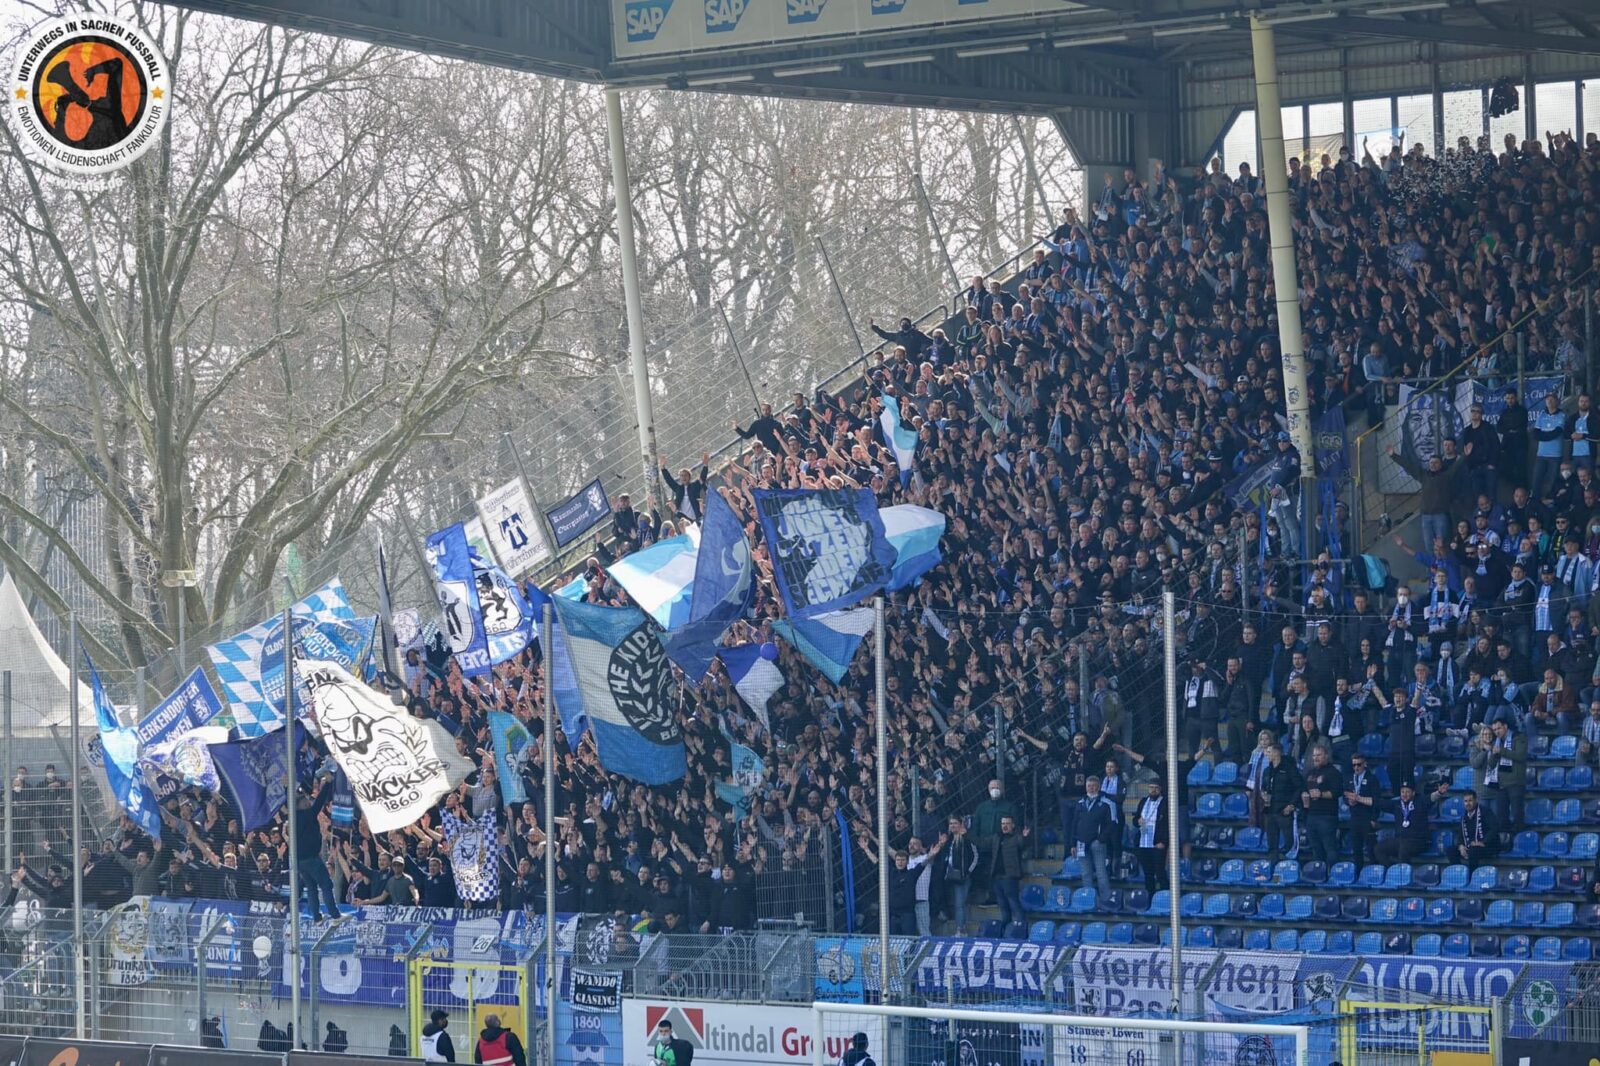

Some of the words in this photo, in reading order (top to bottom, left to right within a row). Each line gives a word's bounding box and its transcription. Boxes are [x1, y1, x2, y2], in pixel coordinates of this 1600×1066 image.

[626, 7, 663, 35] SAP
[705, 0, 743, 26] SAP
[609, 663, 634, 709] THE
[138, 681, 200, 744] ERKENDORFER
[384, 790, 420, 811] 1860
[410, 907, 447, 922] MUSS
[474, 938, 490, 950] 26
[917, 940, 1067, 993] HADERN
[120, 972, 145, 984] 1860
[575, 973, 617, 988] WAMBO
[574, 994, 616, 1006] GIASING
[574, 1016, 601, 1029] 1860
[1112, 1027, 1144, 1039] Löwen
[1069, 1045, 1087, 1064] 18
[1126, 1049, 1145, 1066] 60
